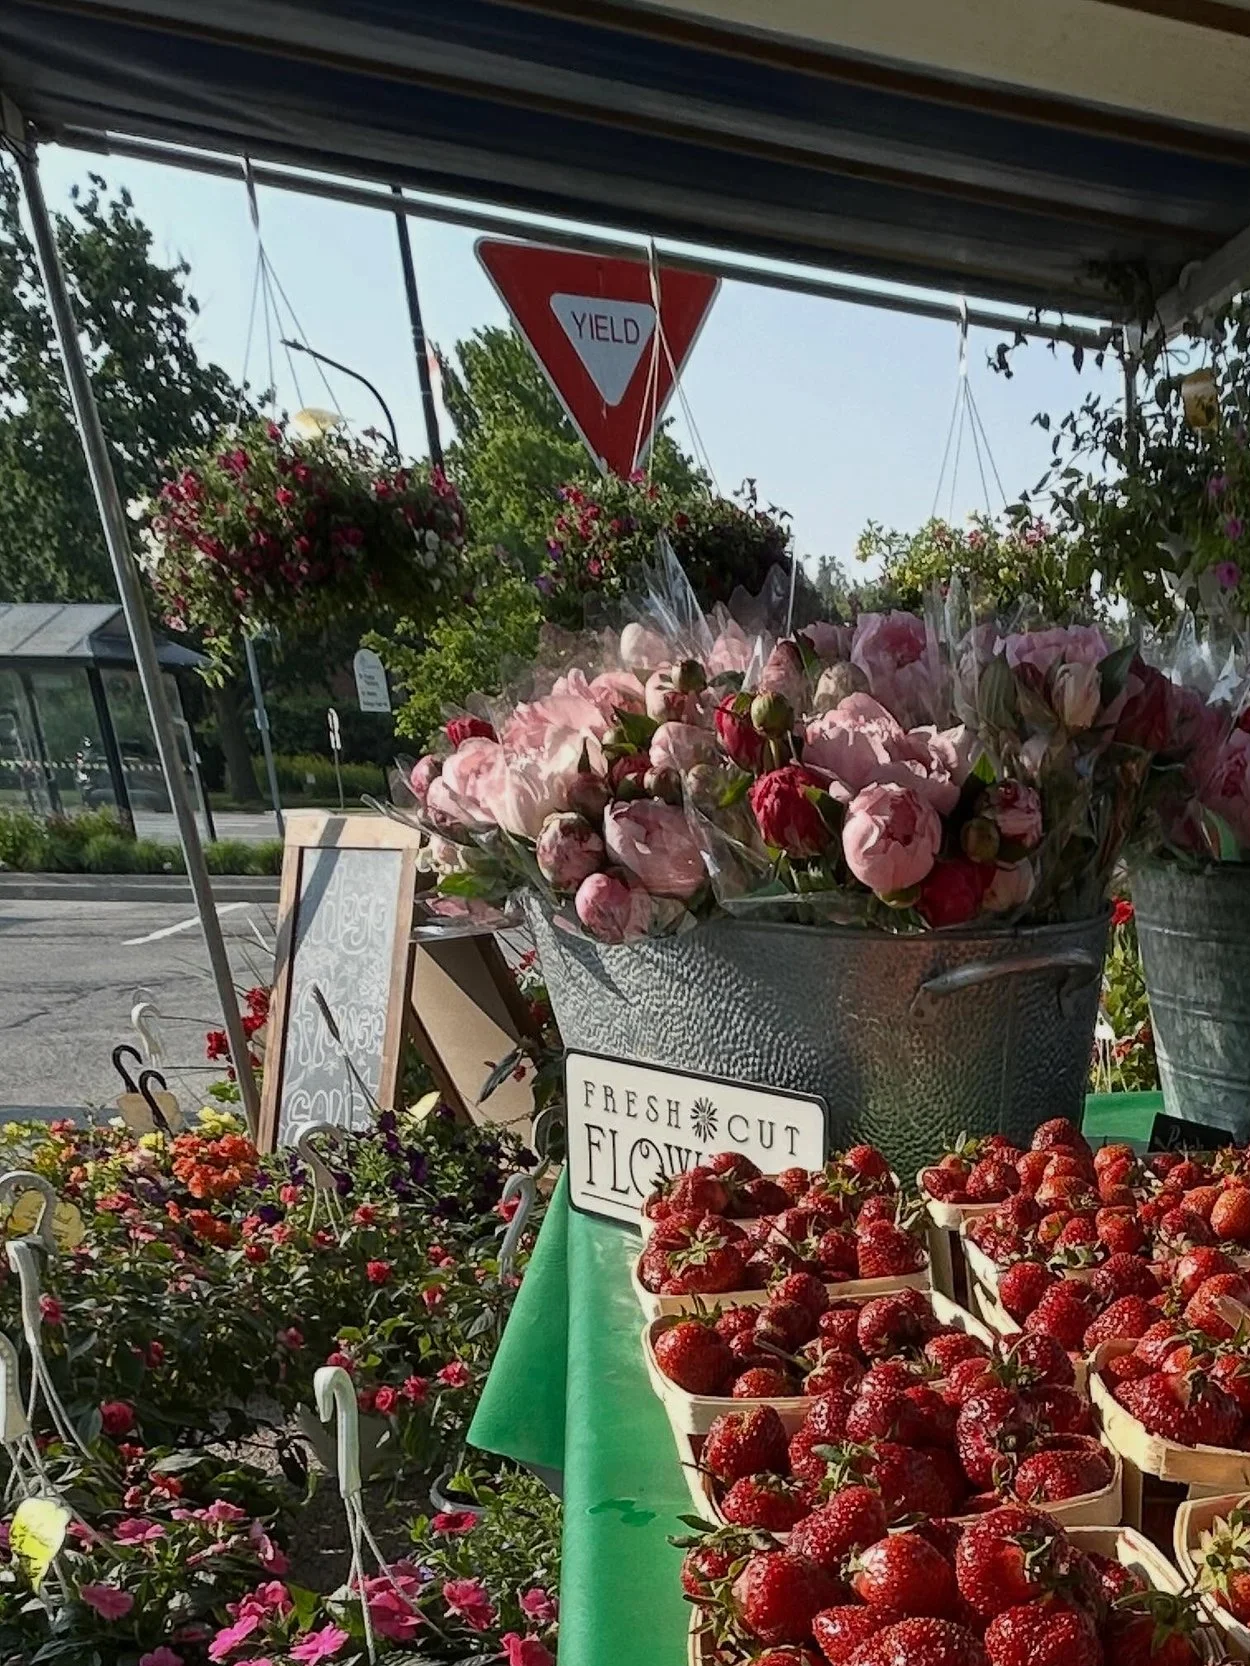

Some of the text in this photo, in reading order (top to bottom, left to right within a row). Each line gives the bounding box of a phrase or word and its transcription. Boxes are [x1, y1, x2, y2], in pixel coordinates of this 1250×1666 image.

[571, 311, 640, 345] YIELD
[583, 1080, 800, 1156] FRESH CUT
